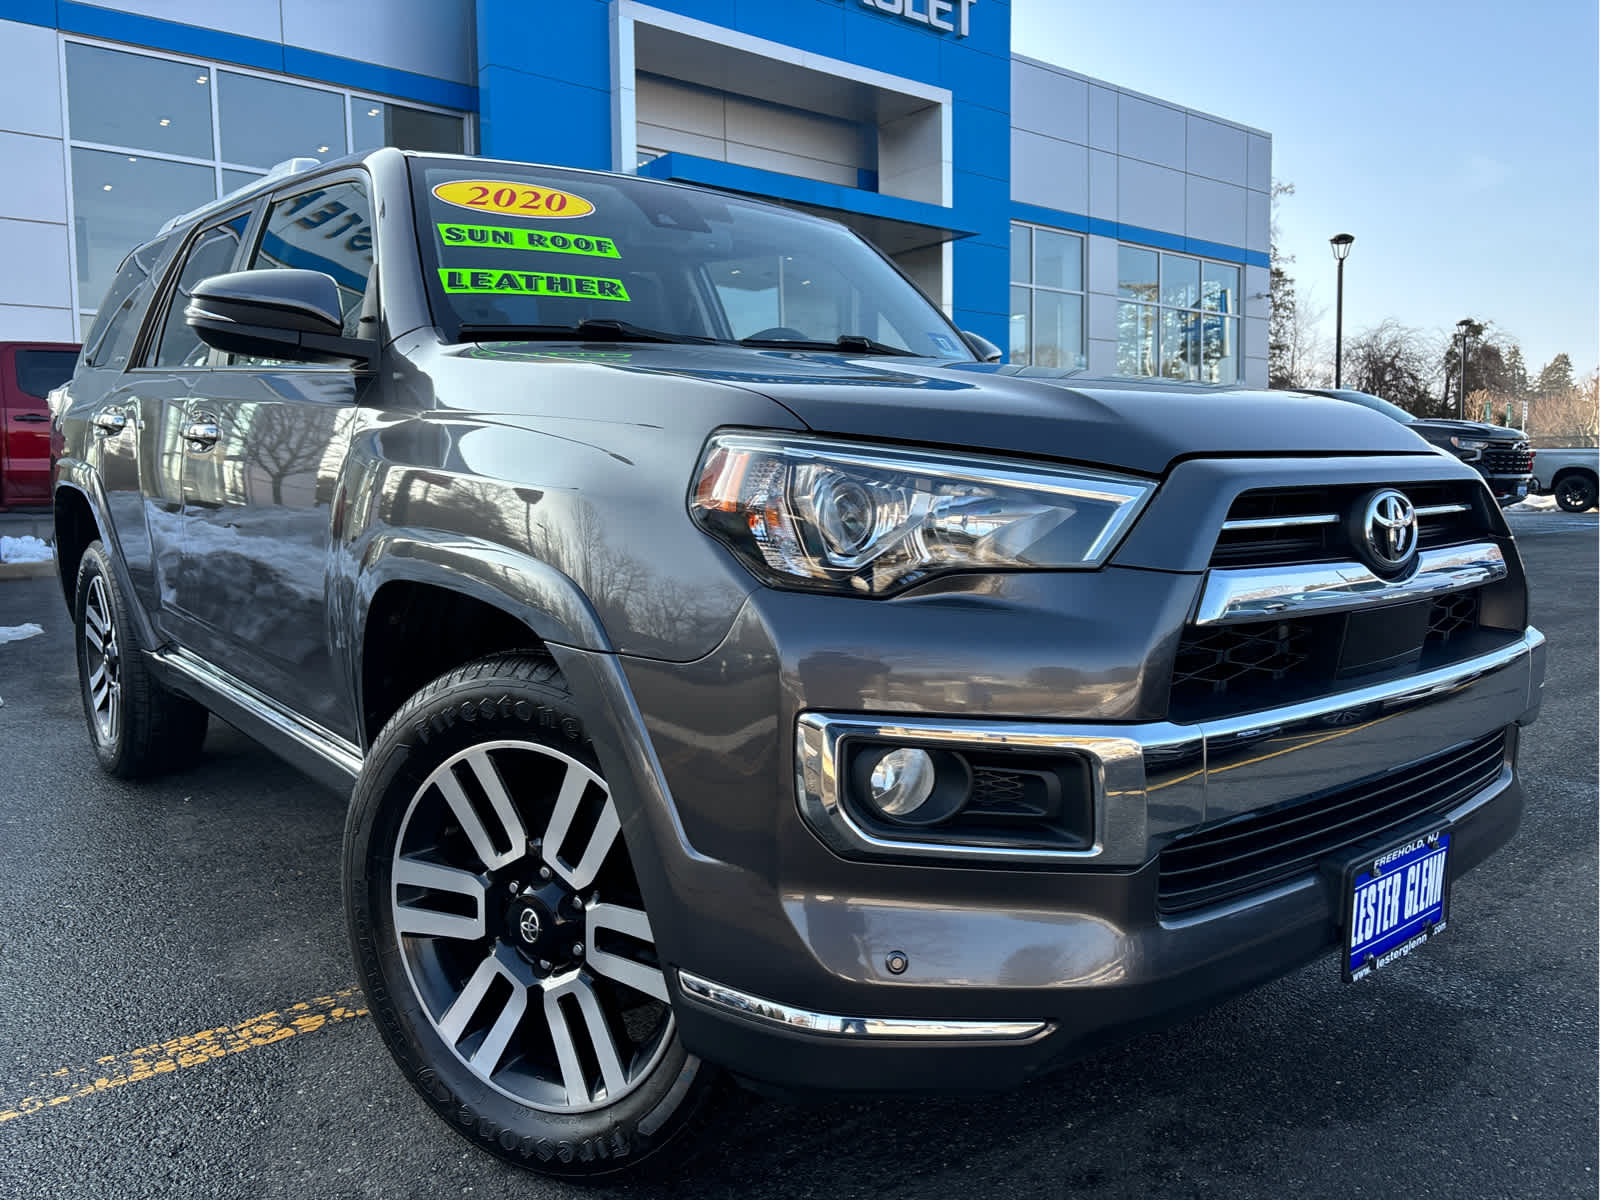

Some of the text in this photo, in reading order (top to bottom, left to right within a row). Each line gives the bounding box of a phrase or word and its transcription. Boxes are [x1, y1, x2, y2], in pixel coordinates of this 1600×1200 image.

[862, 0, 977, 36] LET
[466, 186, 567, 212] 2020
[445, 227, 613, 254] SUN ROOF
[447, 271, 624, 298] LEATHER
[1374, 831, 1440, 869] FREEHOLD, NJ
[1351, 851, 1446, 948] LESTER GLENN
